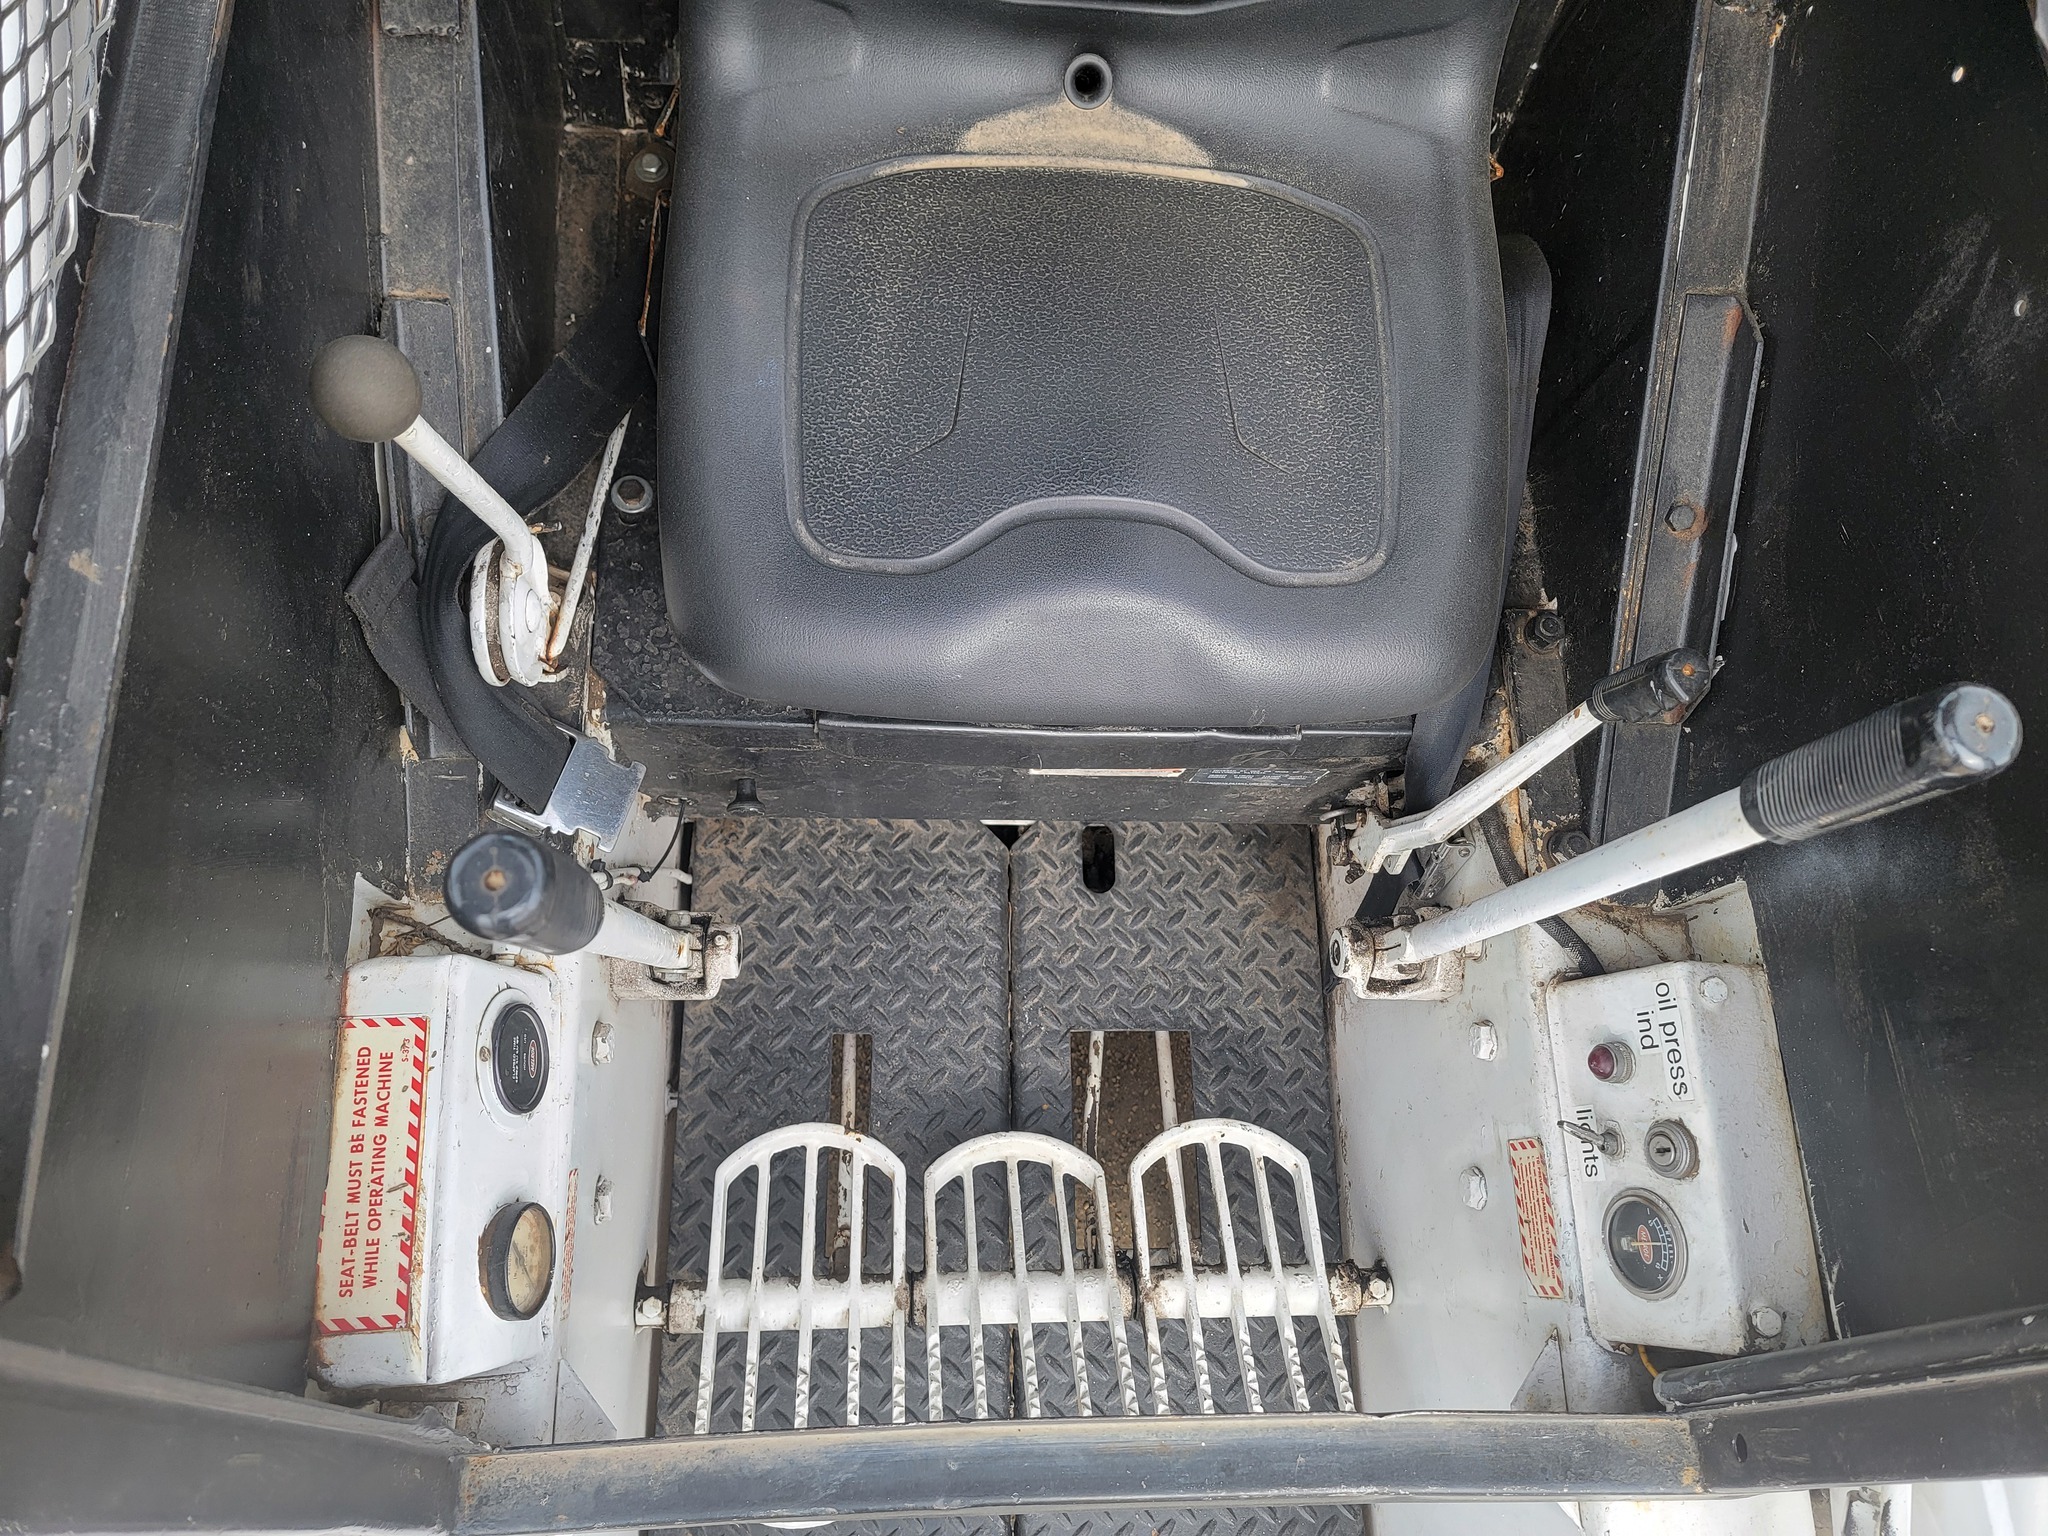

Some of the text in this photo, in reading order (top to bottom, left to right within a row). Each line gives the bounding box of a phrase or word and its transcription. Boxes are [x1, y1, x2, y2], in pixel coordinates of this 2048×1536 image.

[1636, 1010, 1659, 1051] ind
[1655, 982, 1688, 1096] oil press
[338, 1046, 372, 1298] SEAT-BELT MUST BE FASTENED
[362, 1051, 394, 1289] WHILE OPERATING MACHINE
[1536, 1156, 1540, 1165] TO
[1545, 1227, 1550, 1235] TO
[1547, 1237, 1556, 1279] ALTERNATOR
